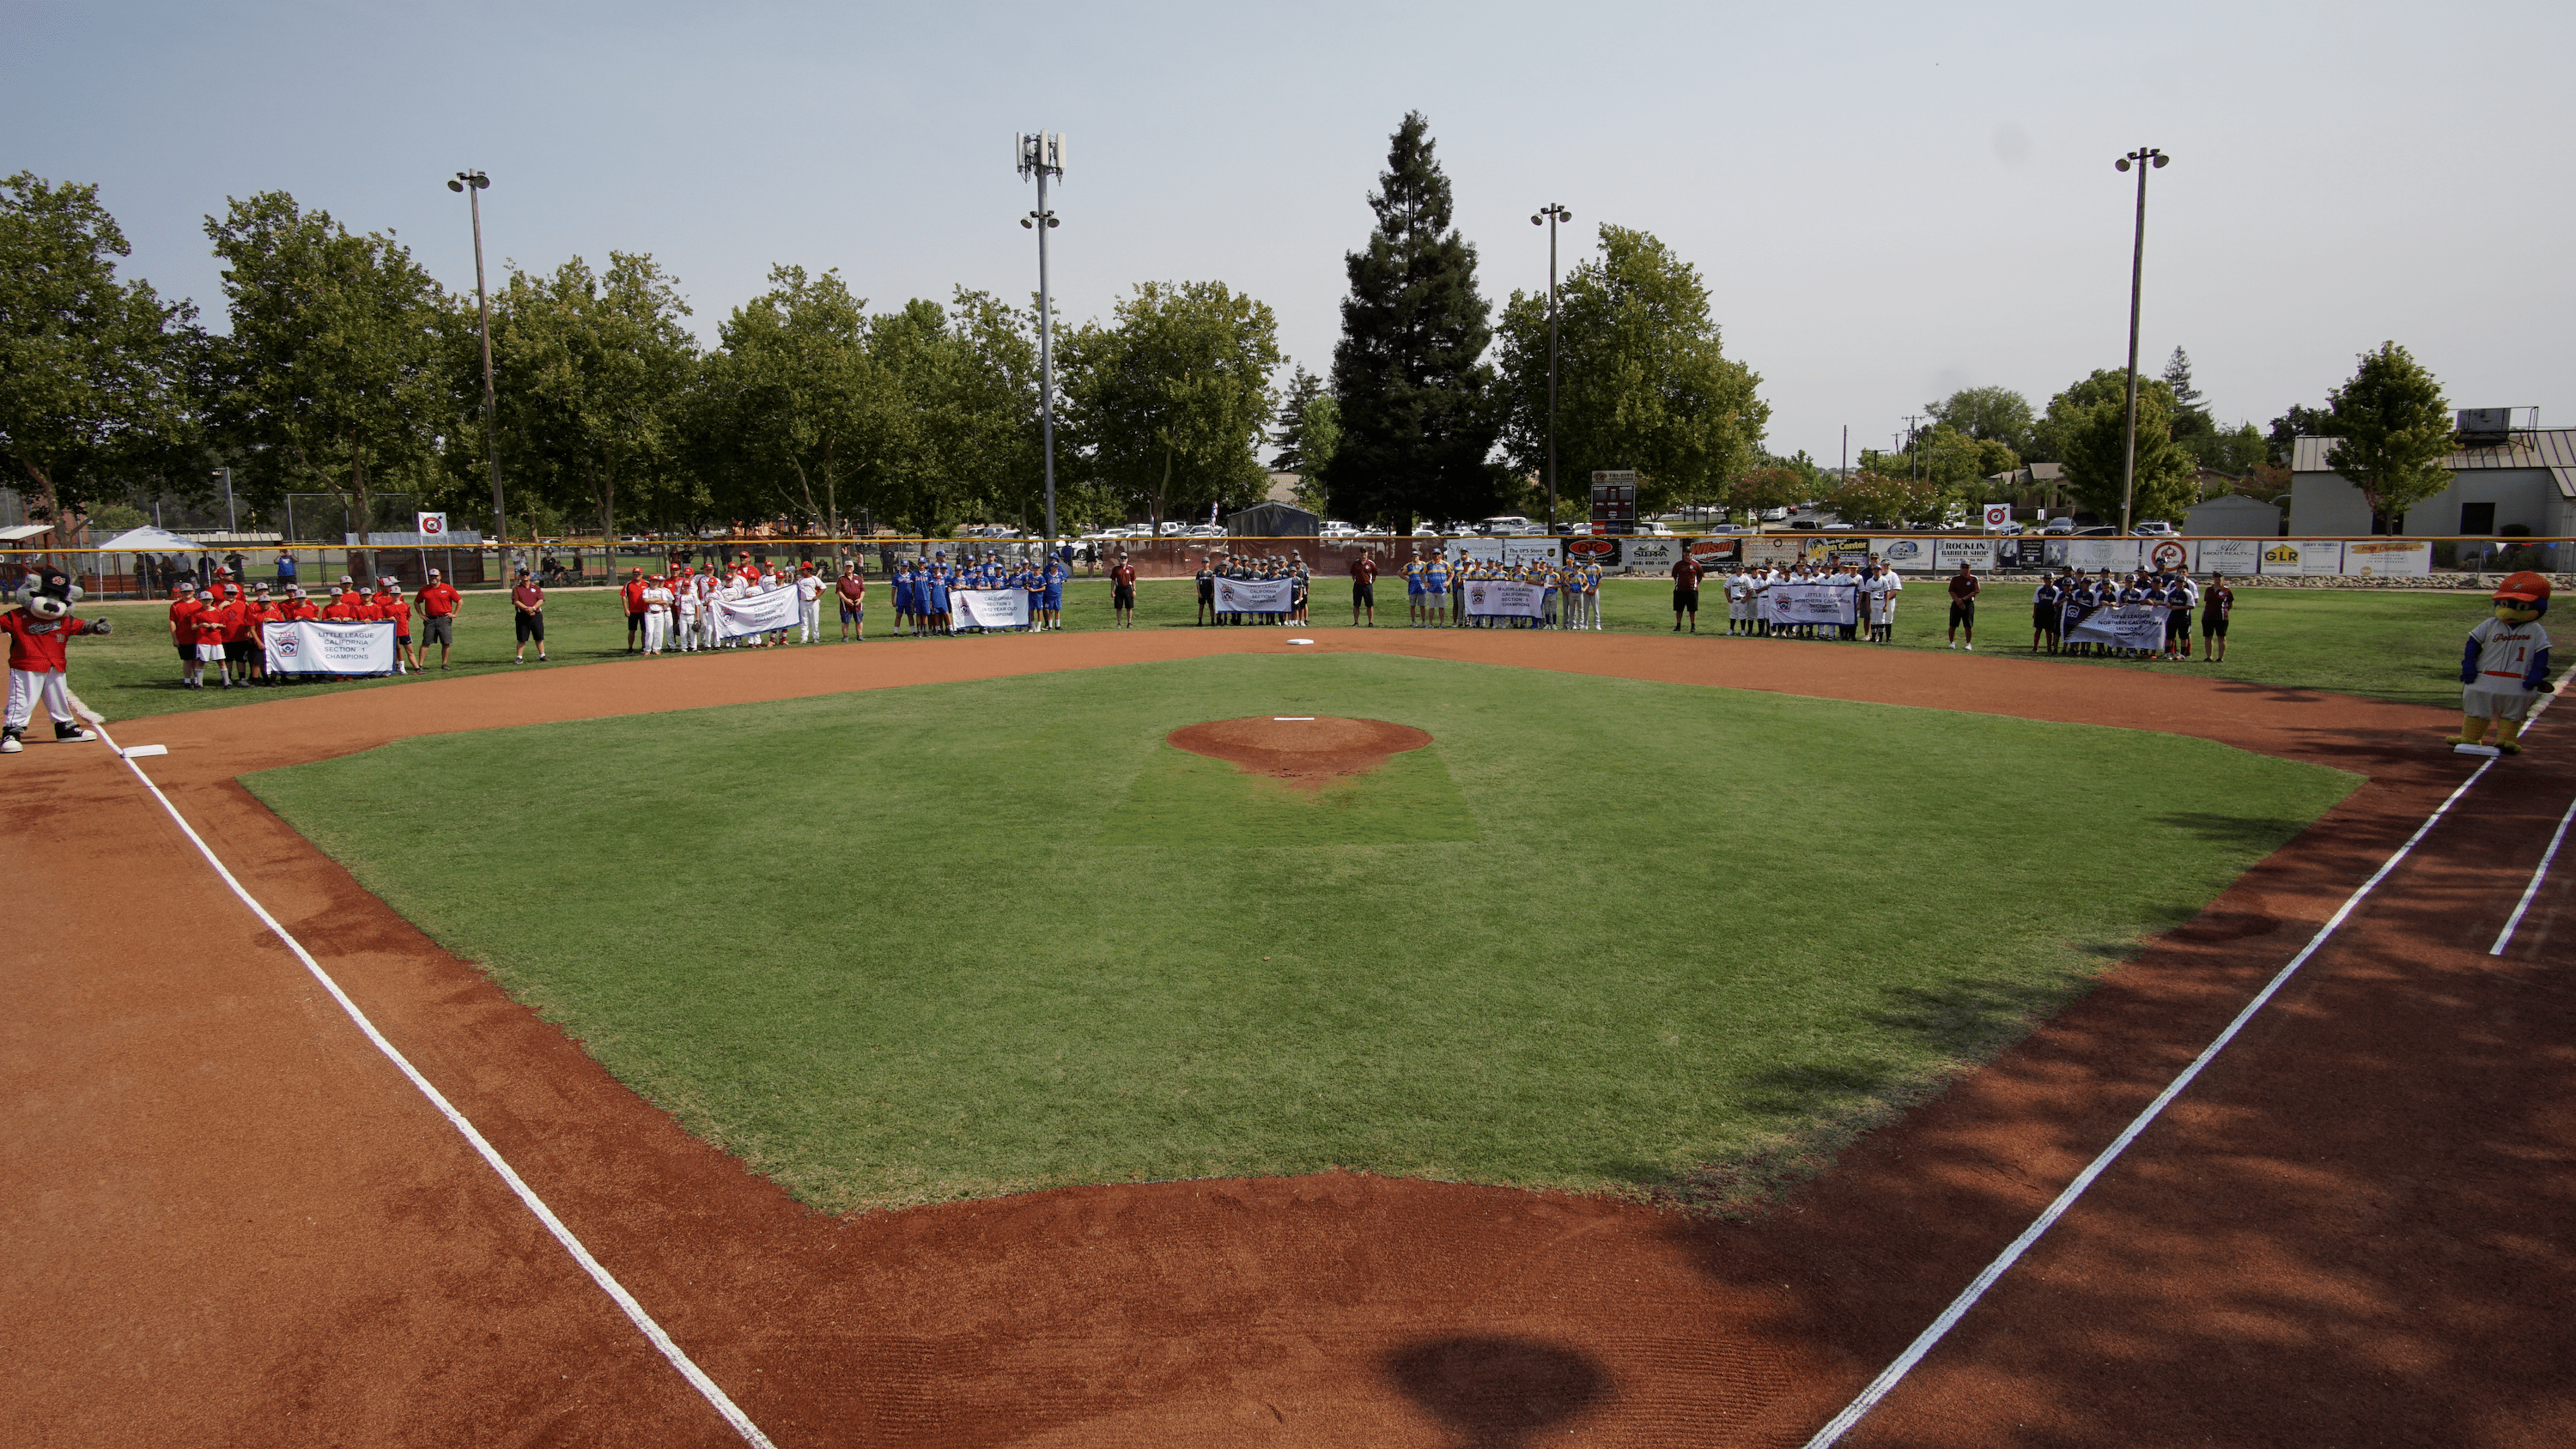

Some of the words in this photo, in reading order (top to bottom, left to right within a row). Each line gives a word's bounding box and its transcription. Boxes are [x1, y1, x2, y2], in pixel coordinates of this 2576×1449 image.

[1578, 541, 1604, 553] QTC
[1692, 540, 1734, 556] Wilson
[1838, 541, 1867, 550] Center
[2265, 552, 2299, 561] GLR
[753, 602, 784, 612] CALIFORNIA
[754, 609, 776, 618] SECTION
[755, 614, 786, 623] CHAMPIONS
[2516, 647, 2525, 662] 1
